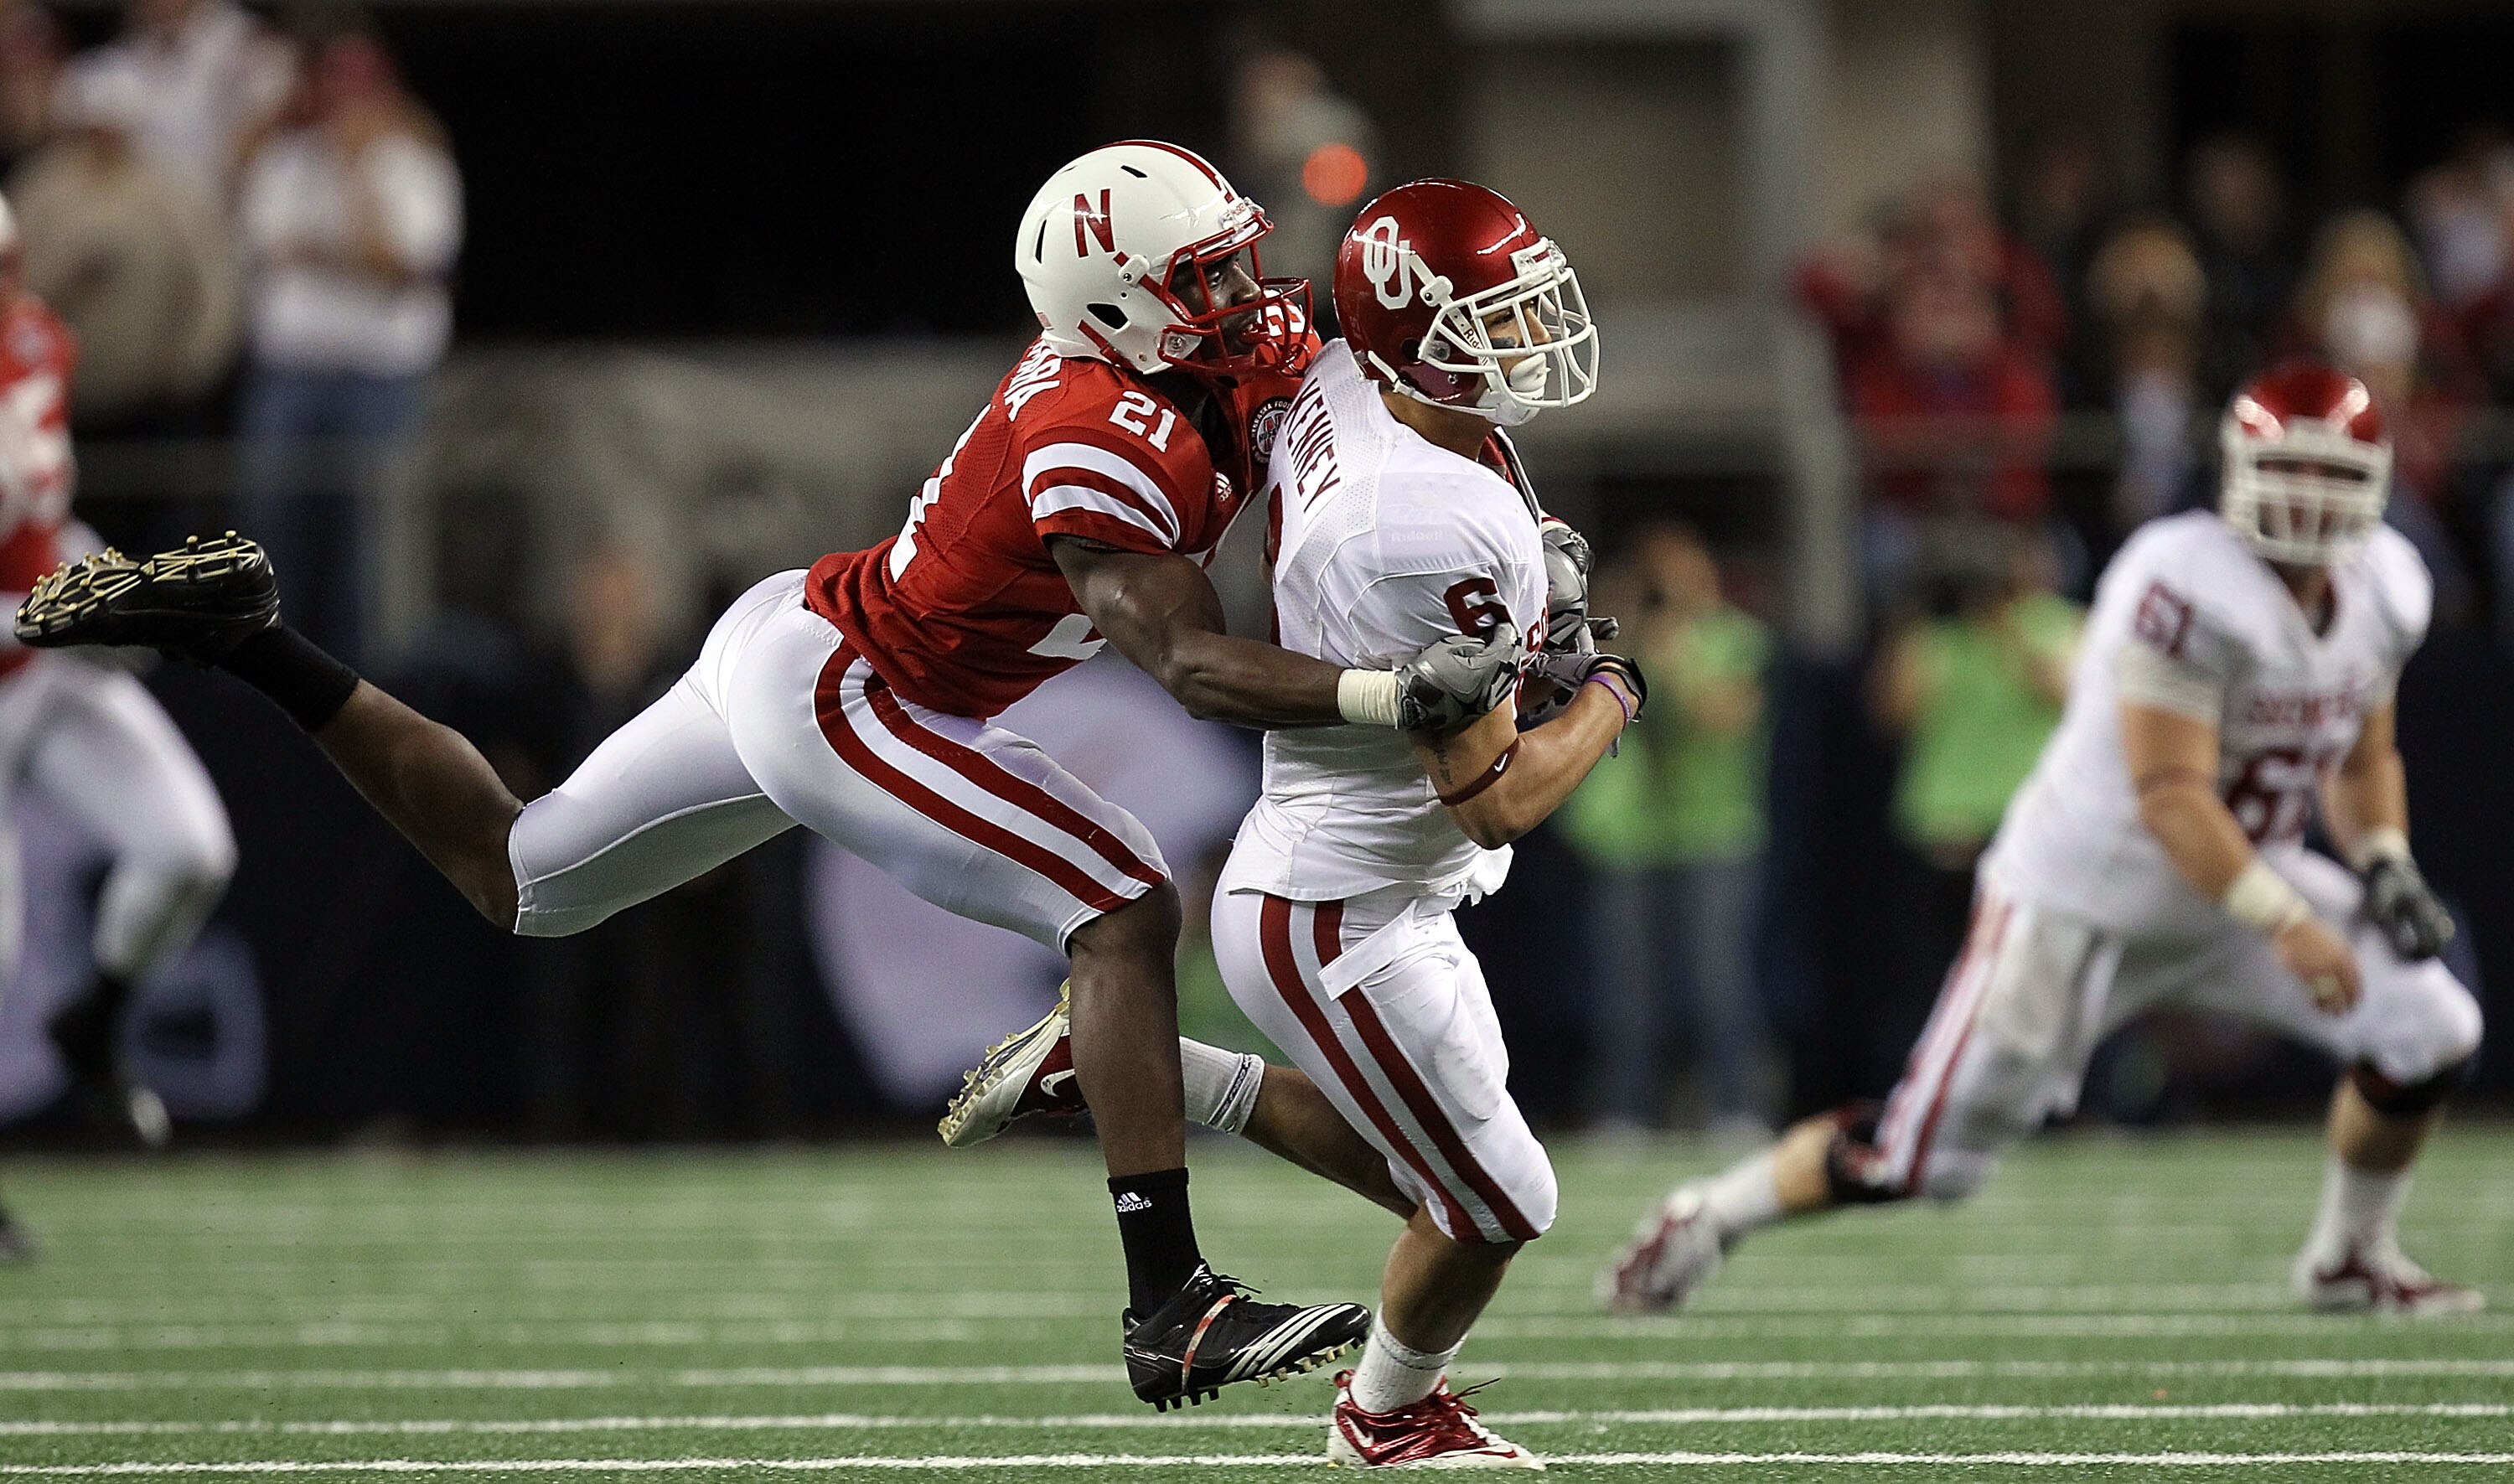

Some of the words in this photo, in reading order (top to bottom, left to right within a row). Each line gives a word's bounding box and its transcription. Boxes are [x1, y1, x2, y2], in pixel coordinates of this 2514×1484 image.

[1073, 188, 1116, 258] N
[1363, 215, 1414, 310] OU
[1108, 390, 1177, 453] 21
[1284, 377, 1341, 514] KENNEY
[1443, 577, 1514, 645] 6
[2135, 581, 2194, 658] 61
[1116, 1200, 1152, 1213] adidas
